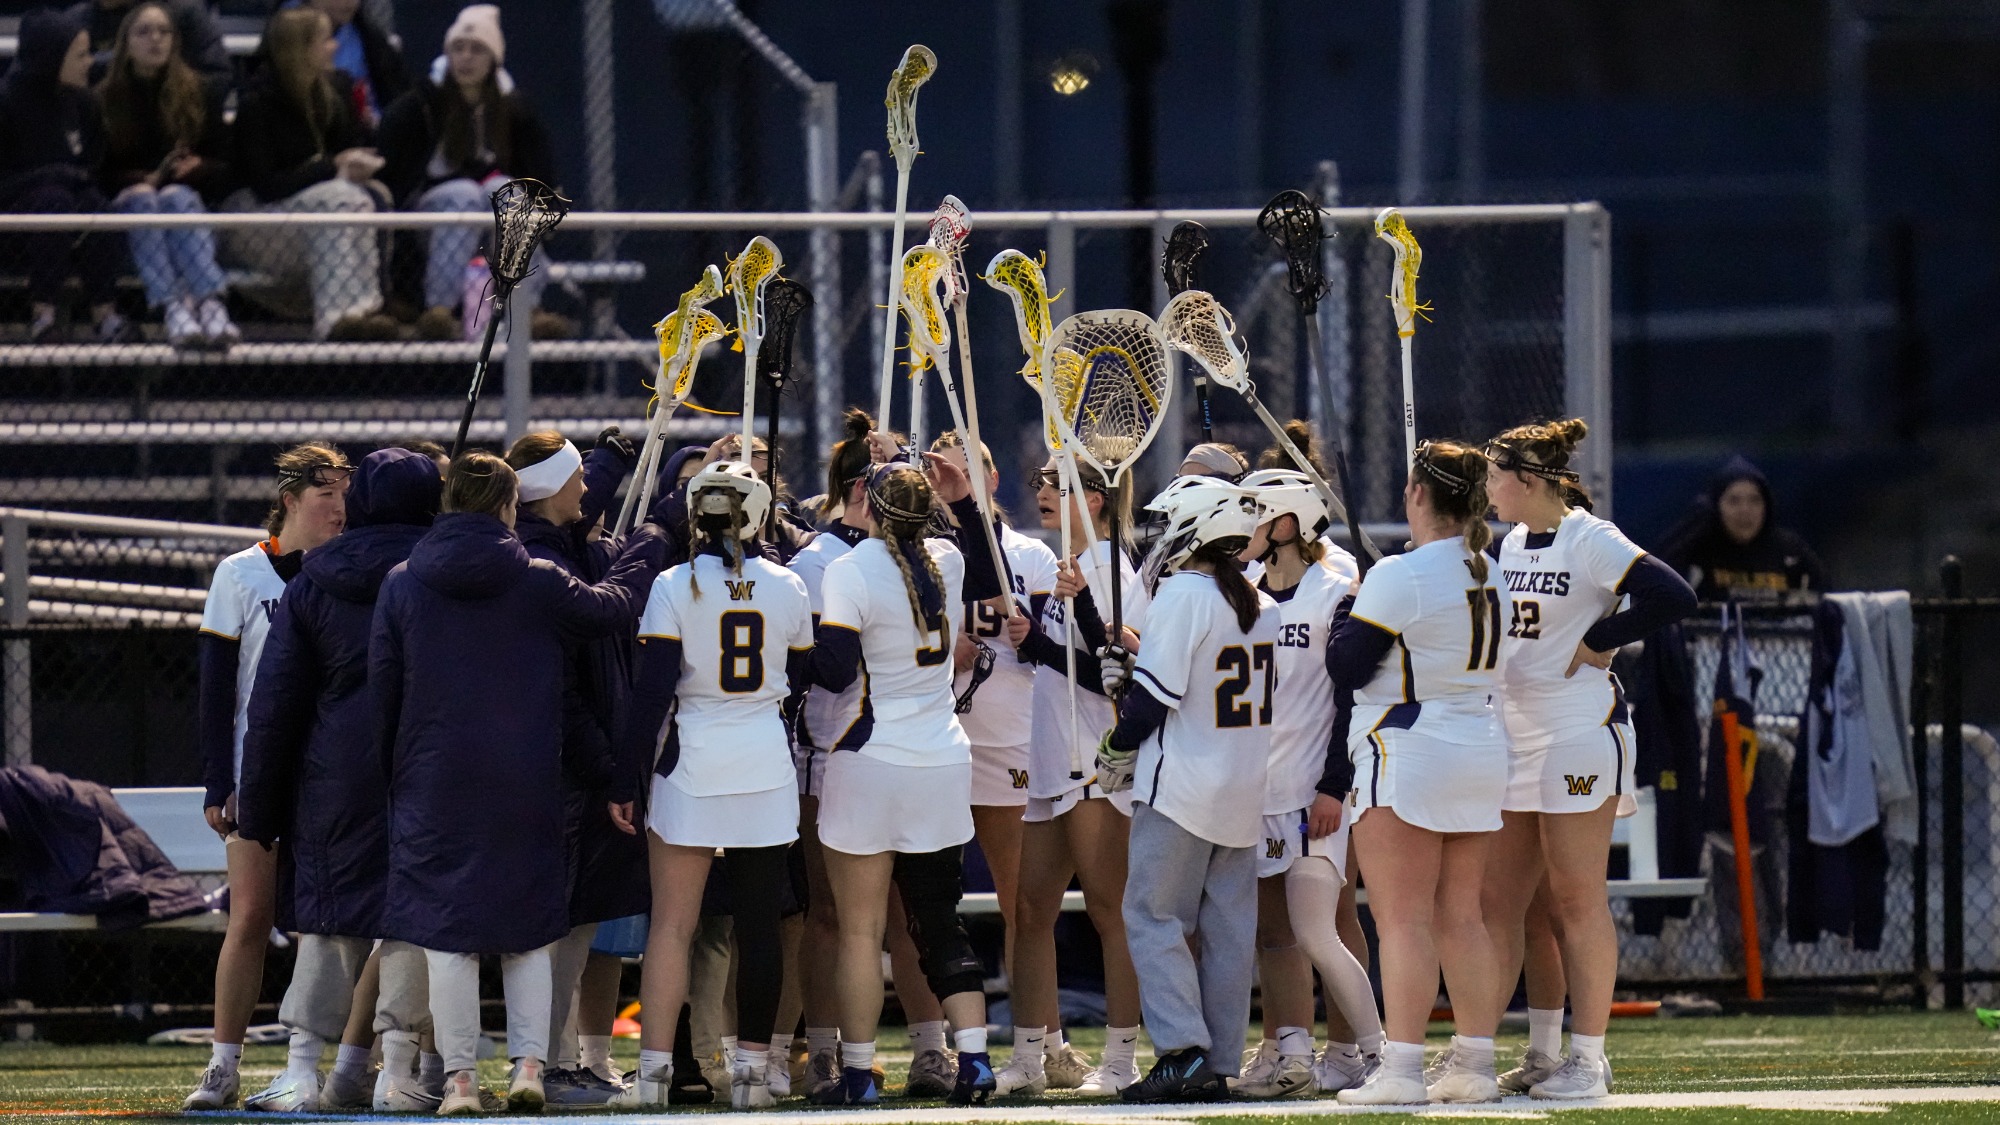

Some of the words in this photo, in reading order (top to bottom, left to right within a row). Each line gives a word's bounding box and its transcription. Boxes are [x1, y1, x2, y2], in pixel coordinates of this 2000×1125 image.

[1405, 401, 1413, 428] GAIT
[724, 580, 756, 601] W
[719, 609, 765, 694] 8
[1214, 641, 1275, 729] 27
[1563, 774, 1599, 796] W
[1265, 837, 1286, 859] W
